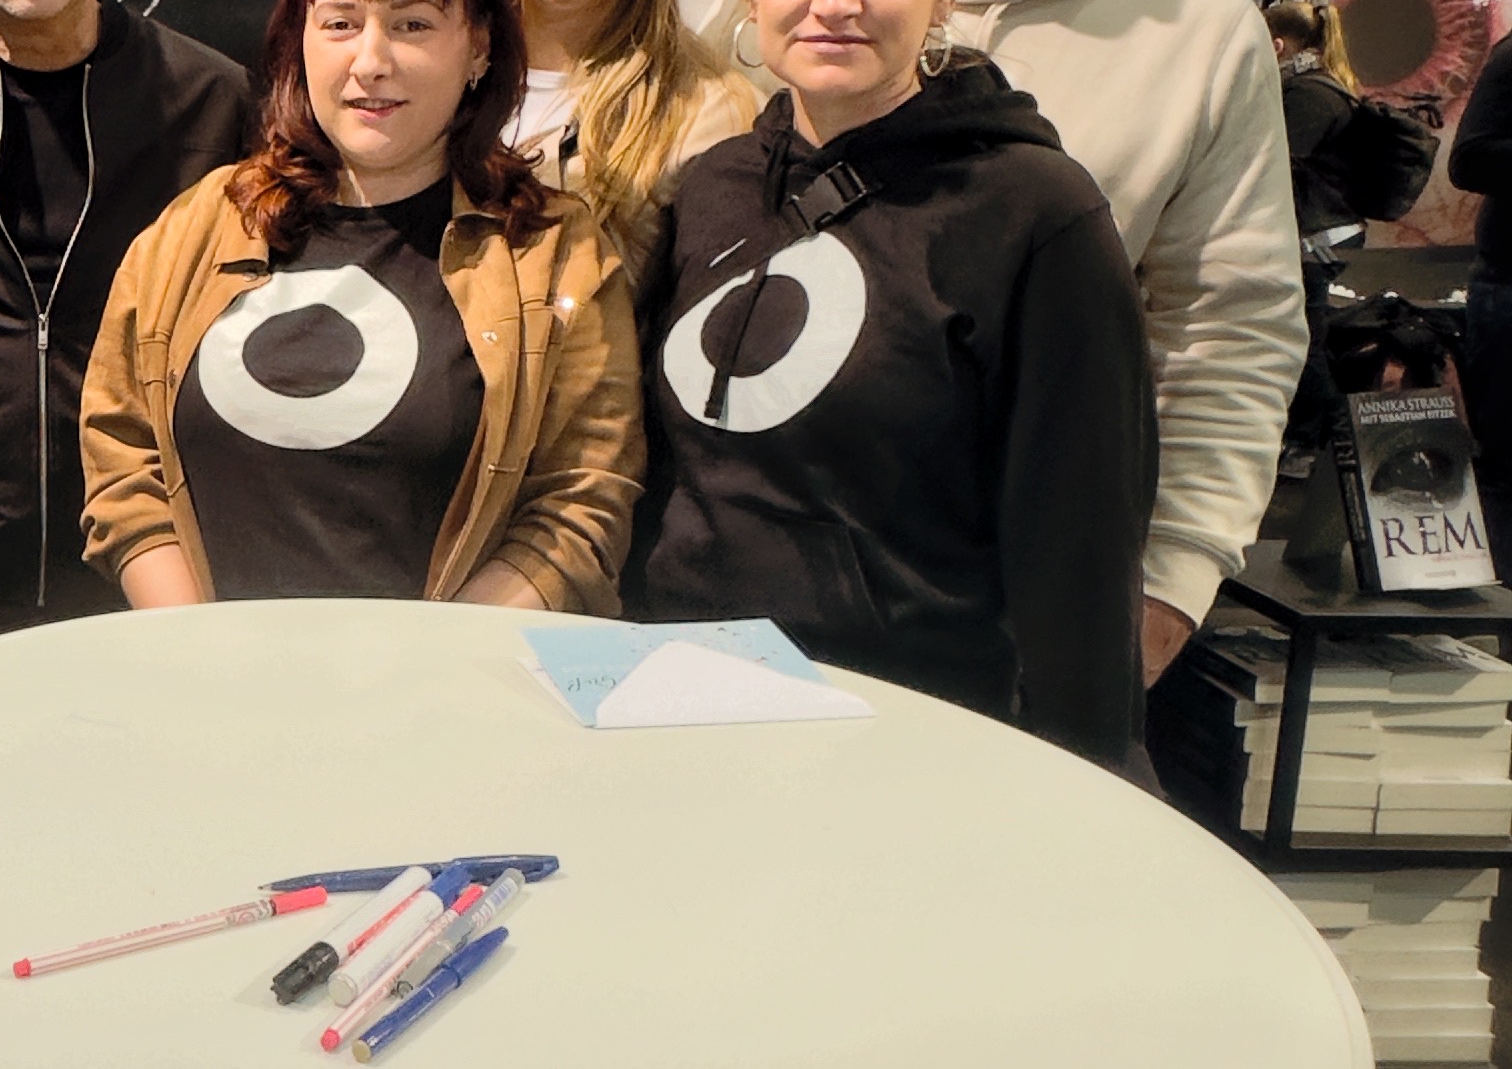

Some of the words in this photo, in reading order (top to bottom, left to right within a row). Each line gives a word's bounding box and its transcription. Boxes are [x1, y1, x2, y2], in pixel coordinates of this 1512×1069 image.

[1358, 400, 1407, 414] ANNIKA
[1408, 396, 1456, 410] STRAUSS
[1379, 512, 1486, 558] REM
